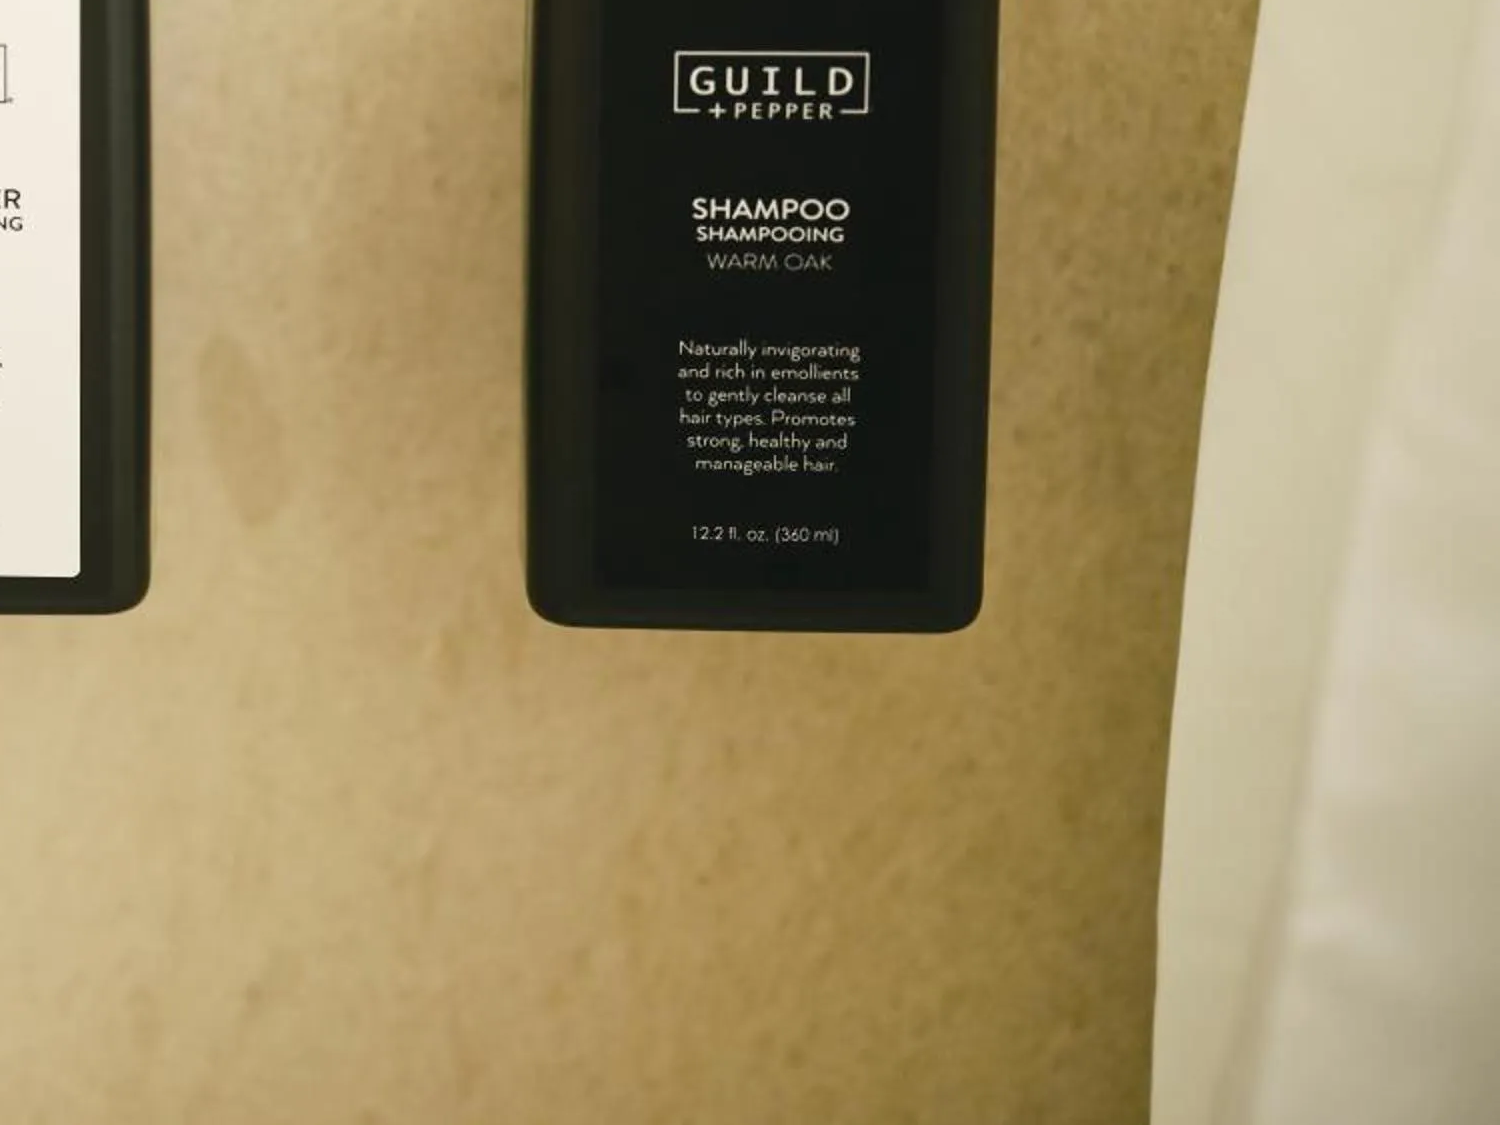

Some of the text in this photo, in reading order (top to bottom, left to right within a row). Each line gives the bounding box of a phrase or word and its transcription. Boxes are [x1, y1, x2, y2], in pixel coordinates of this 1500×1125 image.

[688, 65, 855, 97] GUILD
[691, 197, 851, 221] SHAMPOO
[695, 225, 846, 244] SHAMPOOING
[706, 252, 833, 272] WARM OAK
[678, 339, 861, 364] Naturally invigorating
[677, 362, 860, 381] and rich in emollients
[684, 385, 852, 407] to gently cleanse all
[678, 407, 857, 428] hair types. Promotes
[748, 431, 812, 452] healthy
[815, 432, 848, 450] and
[694, 455, 840, 476] manageable hair.
[691, 525, 840, 546] 12.2 fl. oz. (360 ml)
